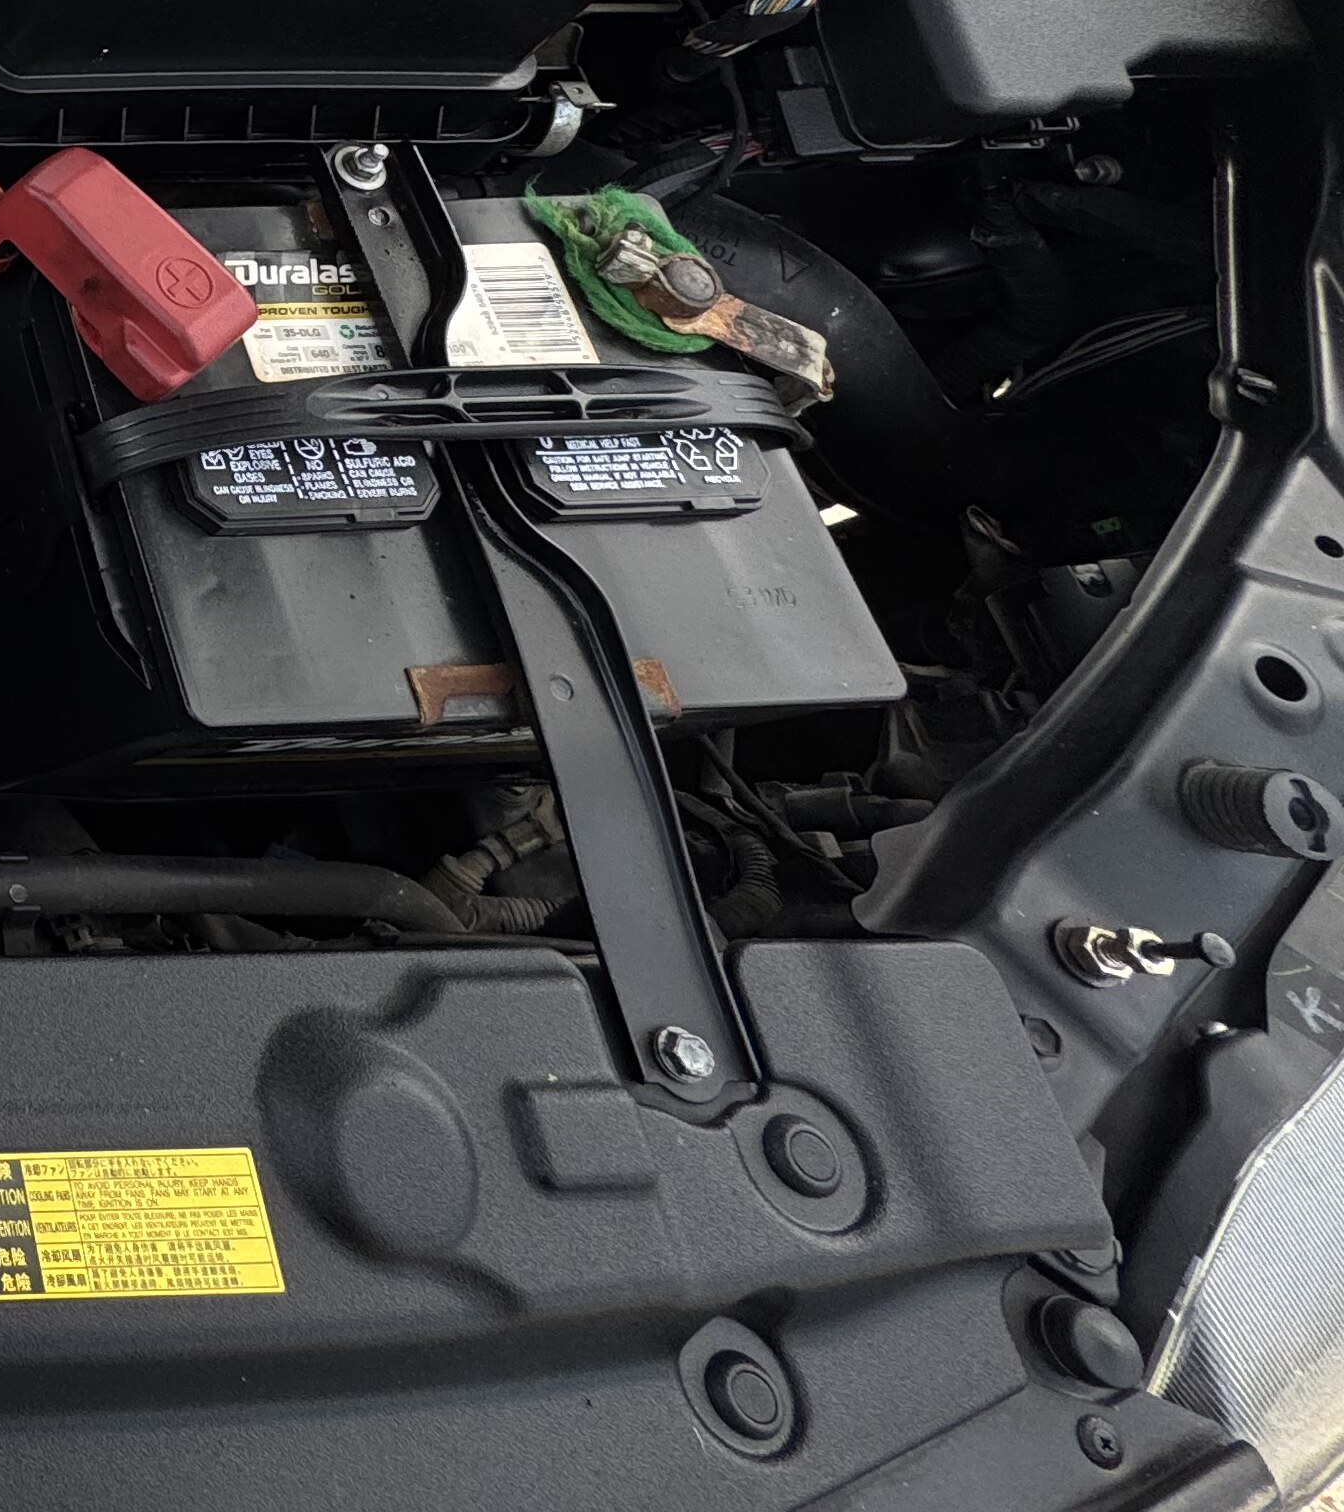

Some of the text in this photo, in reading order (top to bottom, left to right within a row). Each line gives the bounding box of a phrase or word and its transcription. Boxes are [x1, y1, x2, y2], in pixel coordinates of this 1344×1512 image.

[258, 307, 317, 316] PROVEN
[280, 366, 329, 375] DISTRIBUTED
[600, 438, 620, 448] HELP
[621, 437, 641, 447] FAST
[249, 450, 274, 460] EYES
[230, 460, 281, 471] EXPLOSIVE
[306, 460, 323, 471] NO
[345, 456, 416, 469] SULFURIC ACID
[348, 468, 396, 478] CAN CAUSE
[549, 464, 578, 473] FOLLOW
[234, 473, 265, 483] GASES
[301, 472, 334, 481] SPARKS
[305, 481, 338, 490] FLAMES
[353, 479, 398, 488] BLINDNESS
[88, 1181, 110, 1189] AVOID
[189, 1179, 208, 1187] KEEP
[212, 1178, 238, 1186] HANDS
[100, 1190, 122, 1198] FROM
[193, 1188, 216, 1196] START
